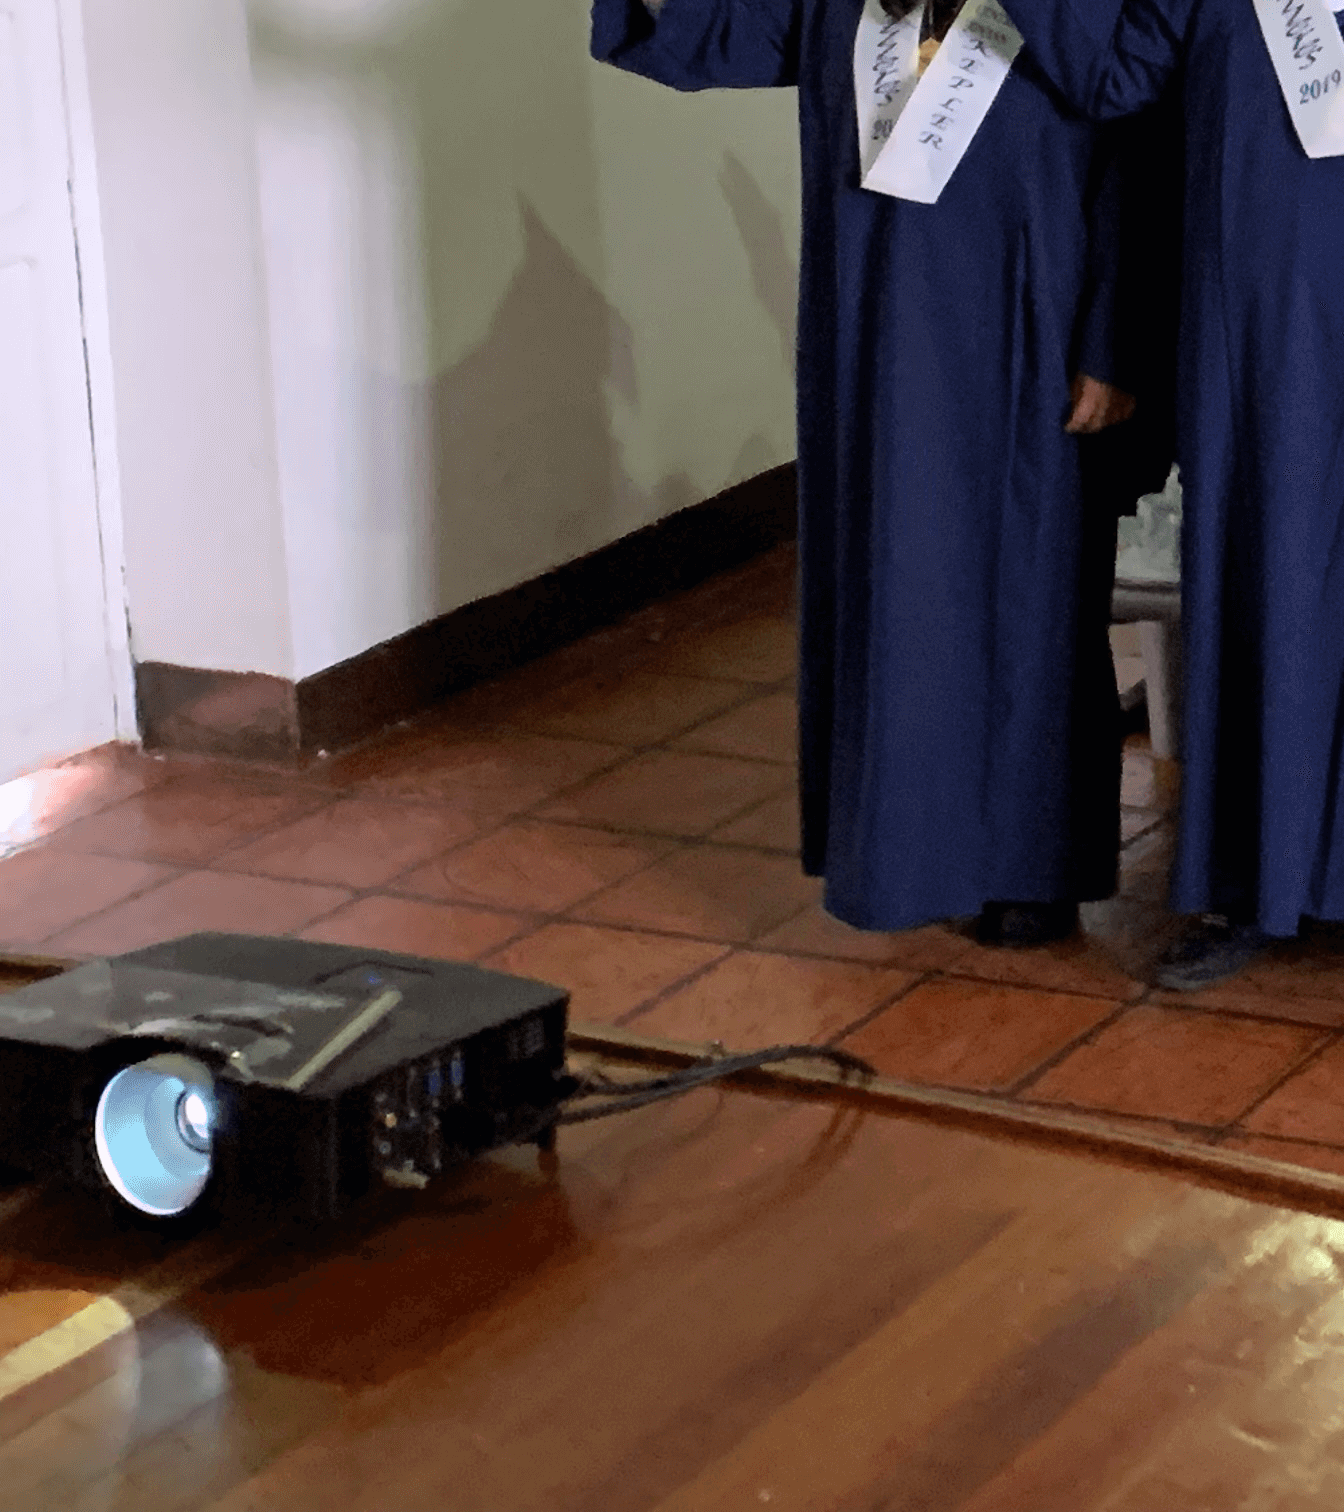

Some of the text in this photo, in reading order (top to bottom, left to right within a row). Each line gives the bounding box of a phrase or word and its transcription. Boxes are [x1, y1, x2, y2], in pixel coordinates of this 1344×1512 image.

[917, 38, 994, 151] KEPLER
[1300, 69, 1341, 104] 2019
[872, 119, 893, 141] 20
